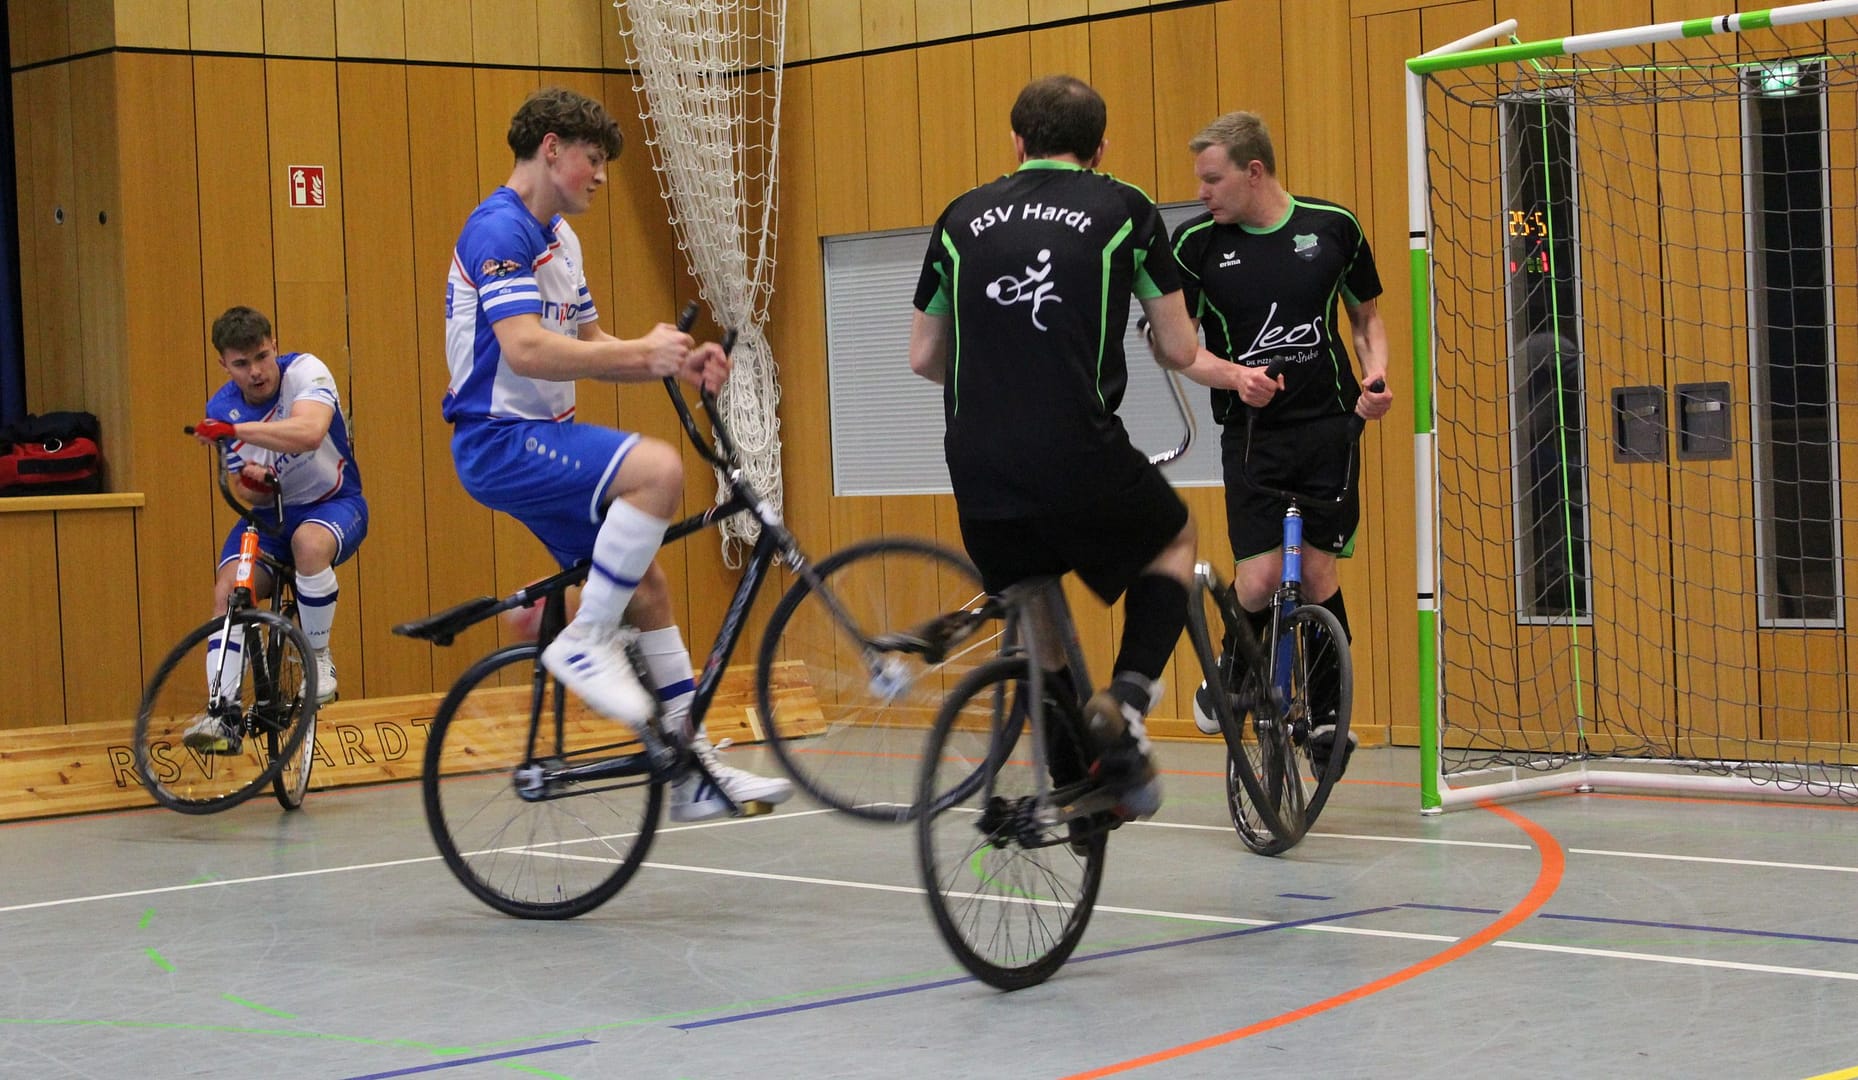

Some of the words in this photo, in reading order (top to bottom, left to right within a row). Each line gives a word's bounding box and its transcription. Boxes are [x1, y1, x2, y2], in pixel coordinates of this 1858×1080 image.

[970, 204, 1014, 237] RSV
[1022, 203, 1092, 233] Hardt
[1219, 259, 1241, 268] erima
[1238, 302, 1322, 360] Leos
[107, 740, 214, 788] RSV
